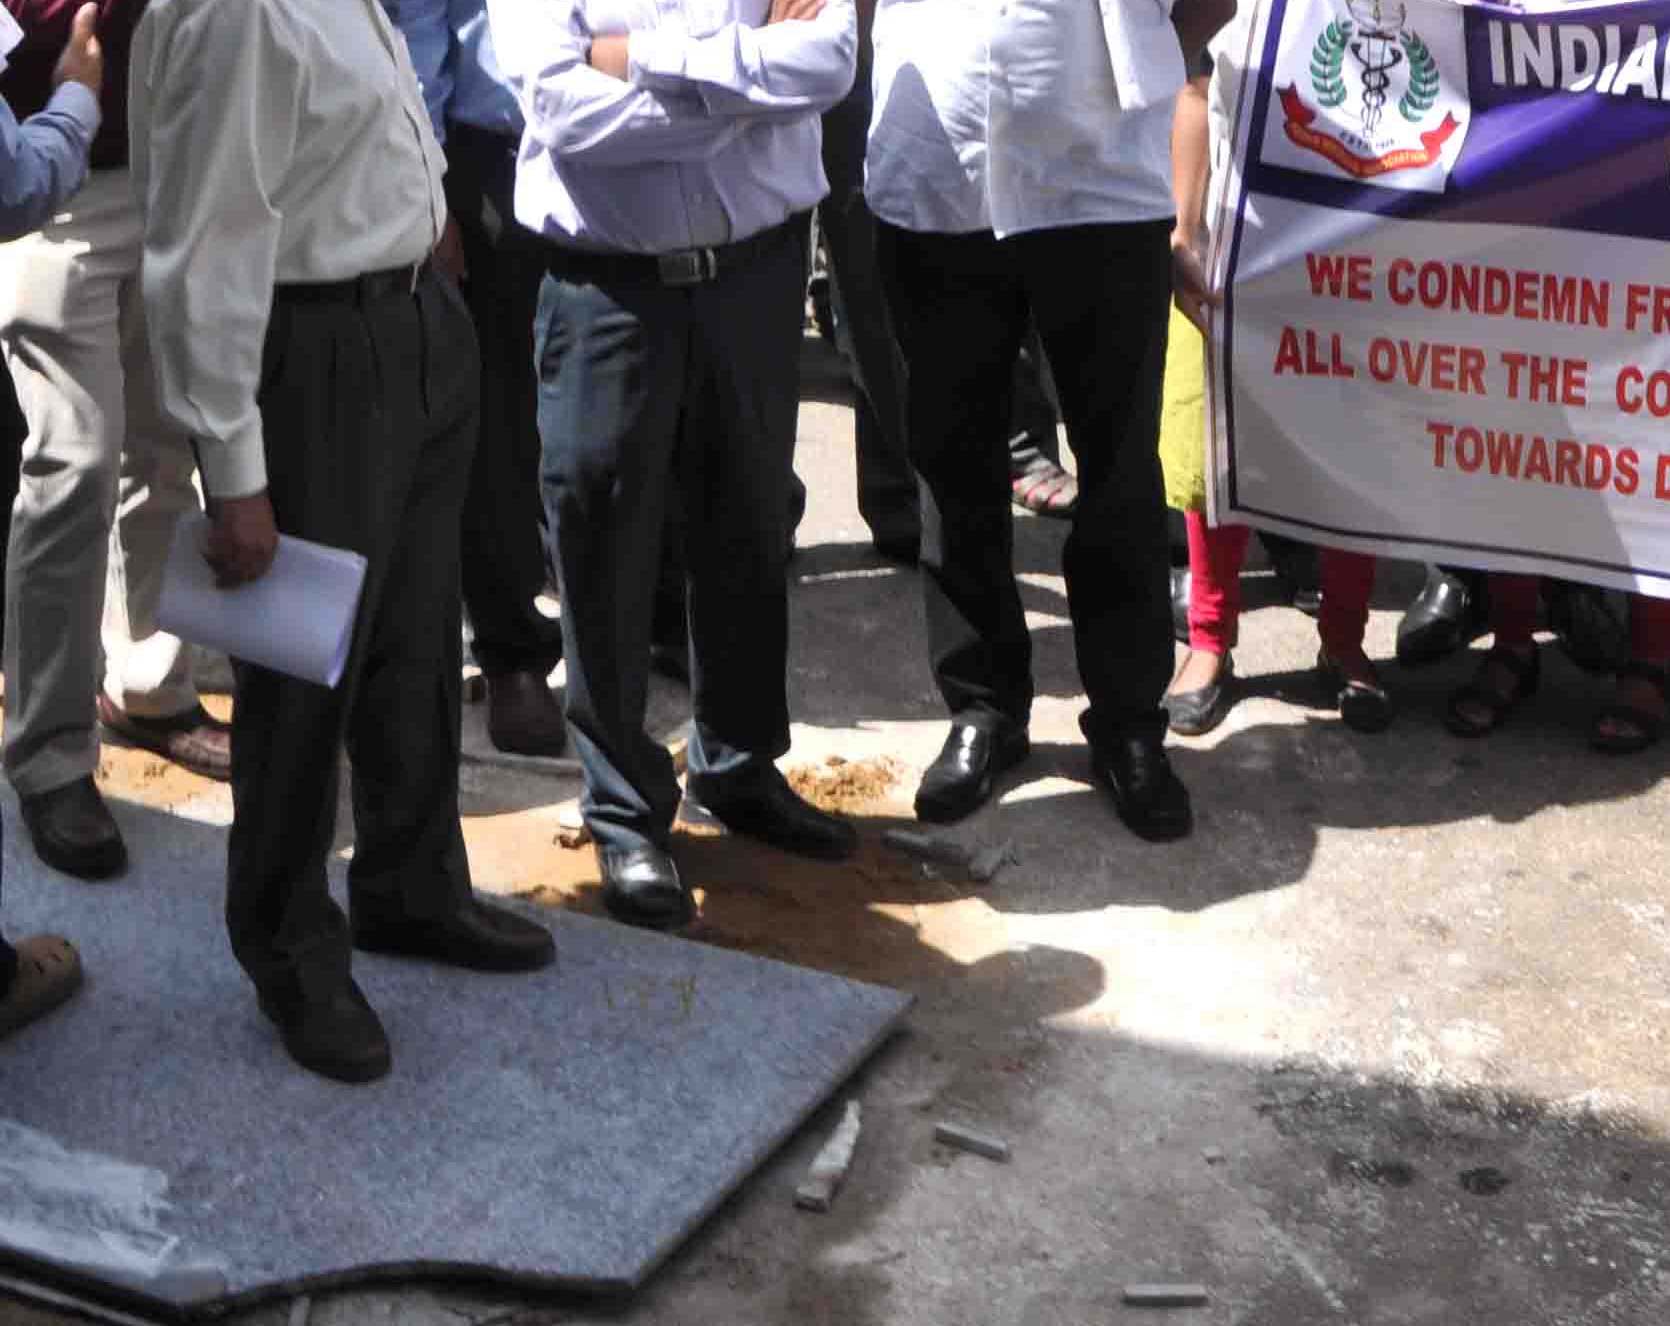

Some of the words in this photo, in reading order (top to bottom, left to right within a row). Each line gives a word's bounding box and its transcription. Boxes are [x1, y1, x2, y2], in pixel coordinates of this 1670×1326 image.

[1305, 253, 1373, 301] WE
[1387, 257, 1610, 329] CONDEMN
[1273, 325, 1355, 379] ALL
[1367, 336, 1487, 395] OVER
[1500, 352, 1588, 407] THE
[1426, 421, 1641, 496] TOWARDS
